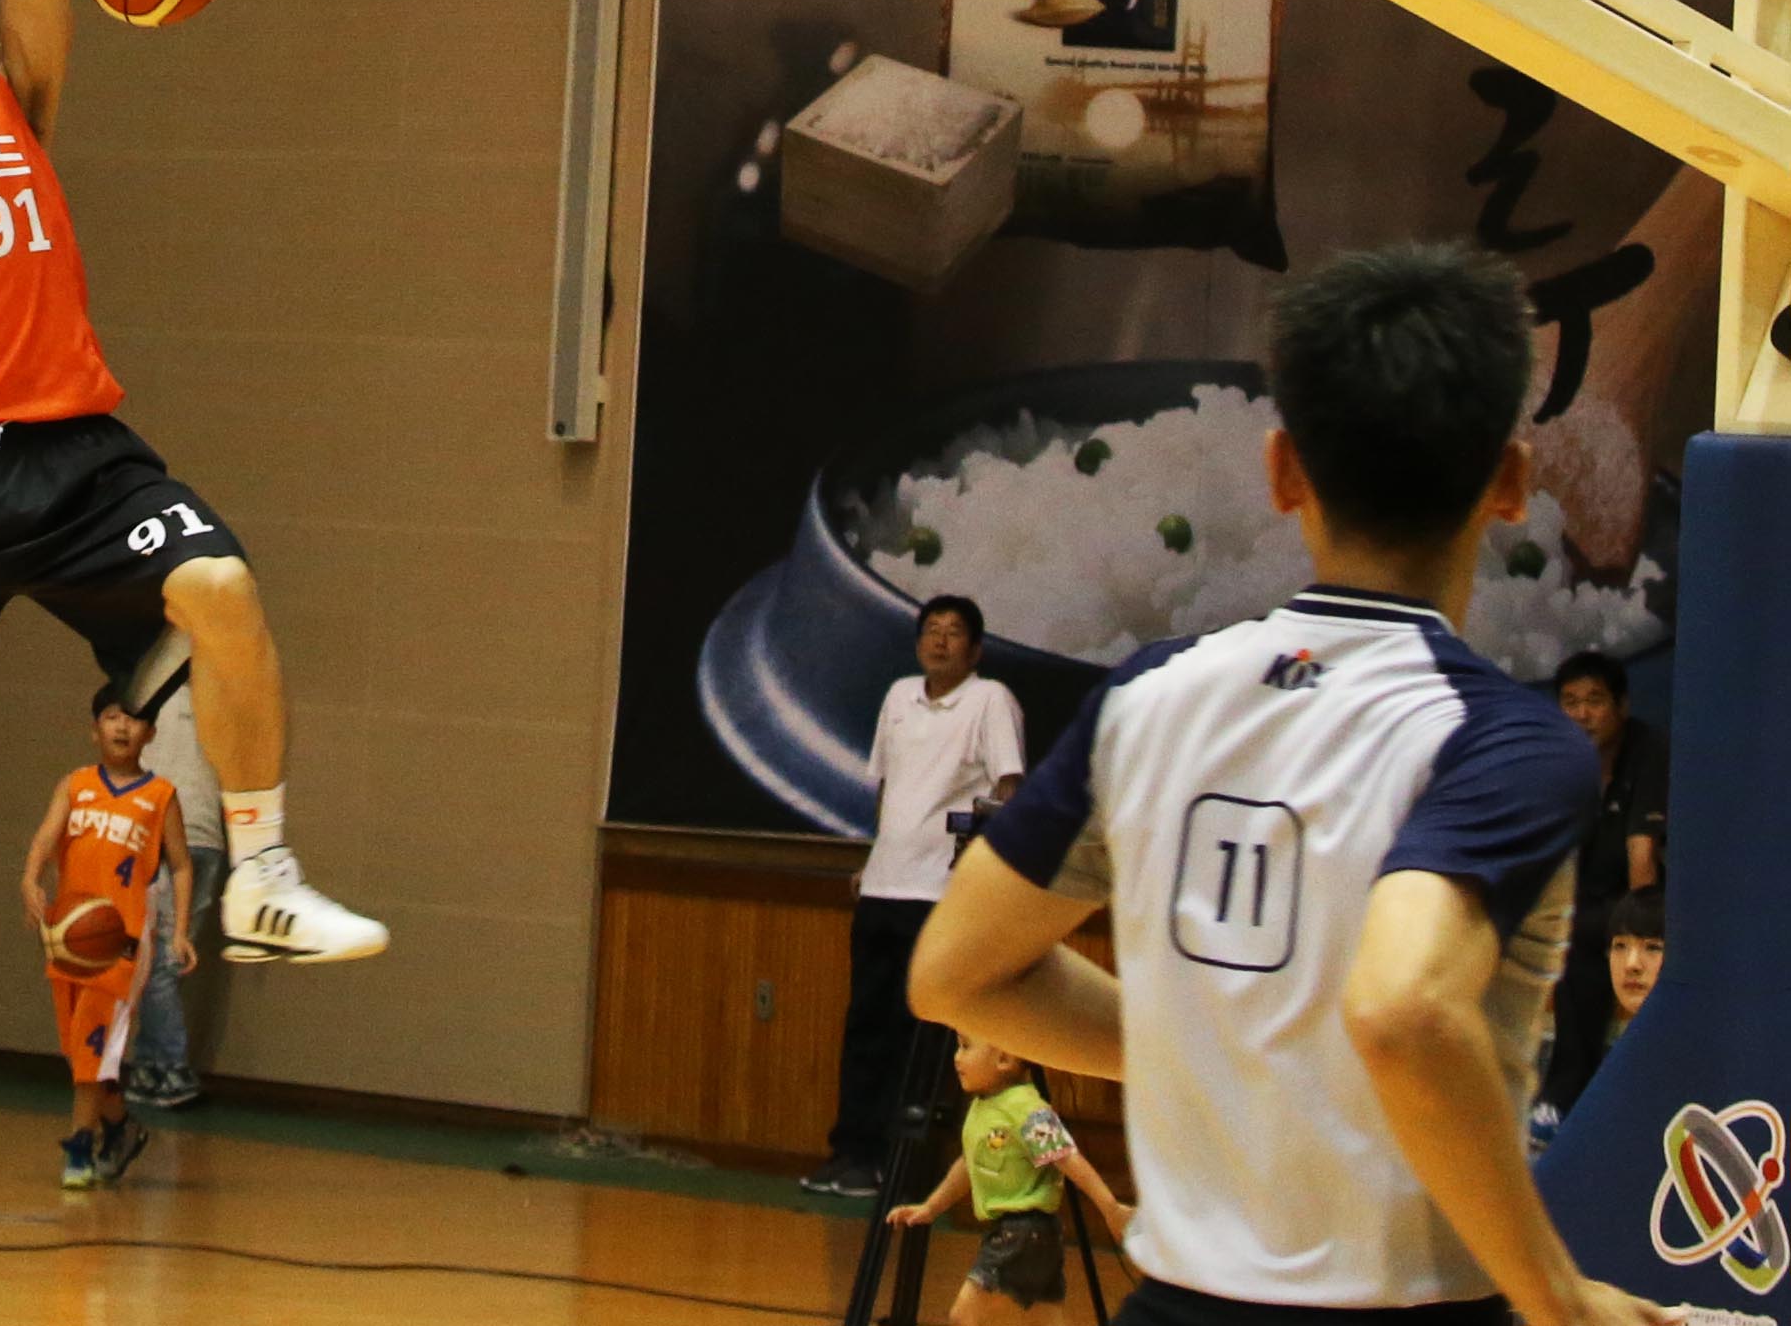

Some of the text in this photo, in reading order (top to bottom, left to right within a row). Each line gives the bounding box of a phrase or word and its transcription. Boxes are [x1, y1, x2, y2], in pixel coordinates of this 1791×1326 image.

[126, 501, 215, 558] 91
[115, 855, 137, 888] 4
[1216, 838, 1269, 928] 11
[85, 1024, 107, 1058] 4
